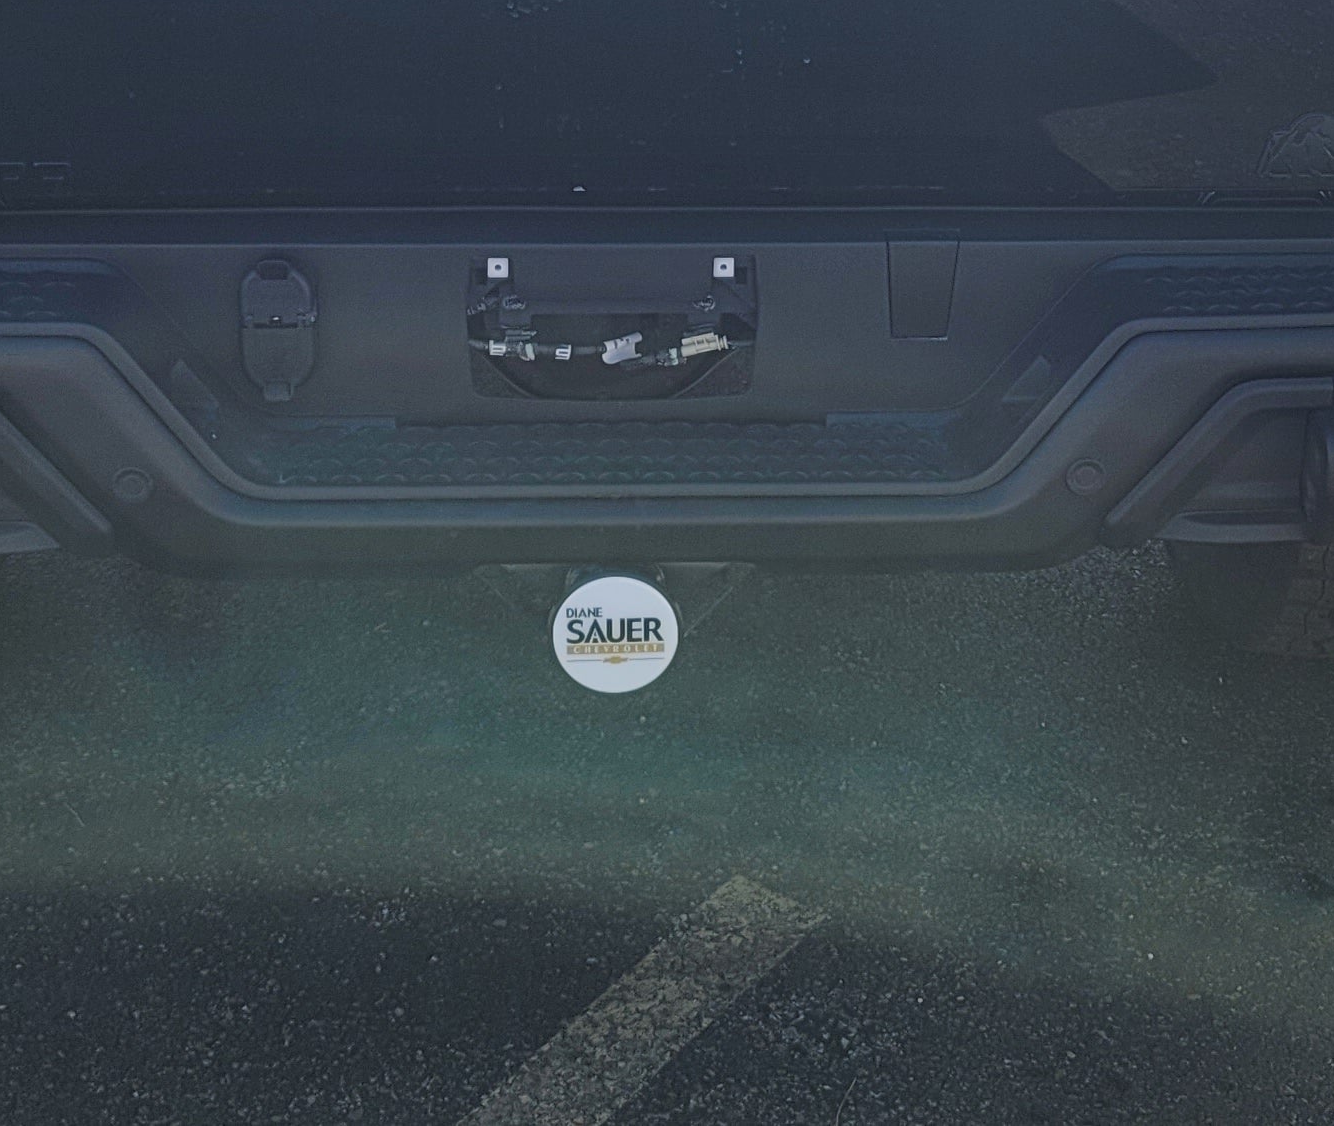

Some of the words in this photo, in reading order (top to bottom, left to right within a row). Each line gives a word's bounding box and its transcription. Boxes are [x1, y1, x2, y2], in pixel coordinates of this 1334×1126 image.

[566, 607, 603, 618] DIANE
[566, 617, 664, 644] SAUER
[573, 644, 659, 654] CHEVROLET
